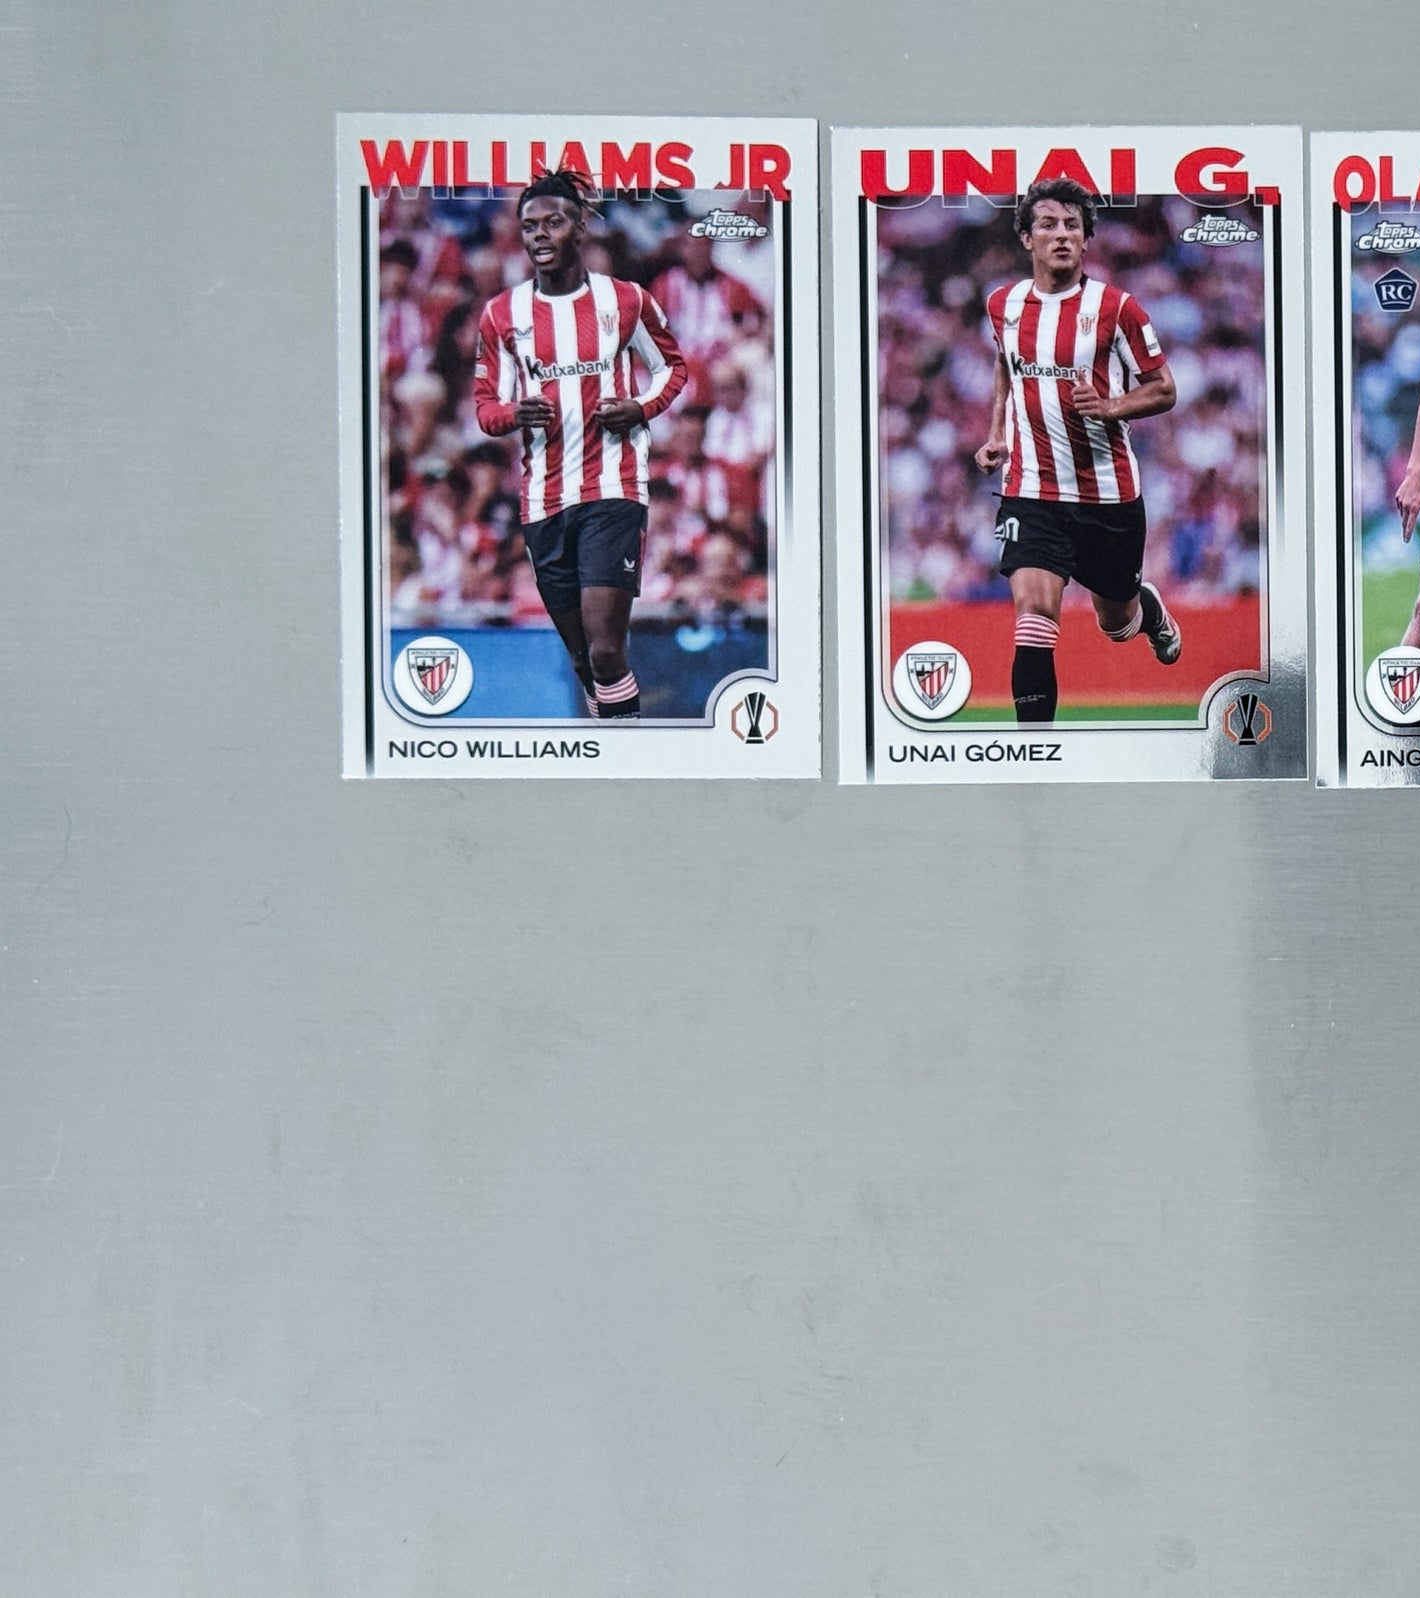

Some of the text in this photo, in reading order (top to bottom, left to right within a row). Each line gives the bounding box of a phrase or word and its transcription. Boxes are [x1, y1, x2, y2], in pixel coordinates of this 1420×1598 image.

[360, 139, 792, 202] WILLIAMS JR
[860, 147, 1137, 209] UNAI
[690, 222, 769, 238] Chrome
[1182, 227, 1259, 243] Chrome
[1380, 284, 1413, 301] RC
[525, 355, 612, 380] Kutxabank
[388, 740, 601, 759] NICO WILLIAMS
[888, 740, 1063, 763] UNAI GÓMEZ
